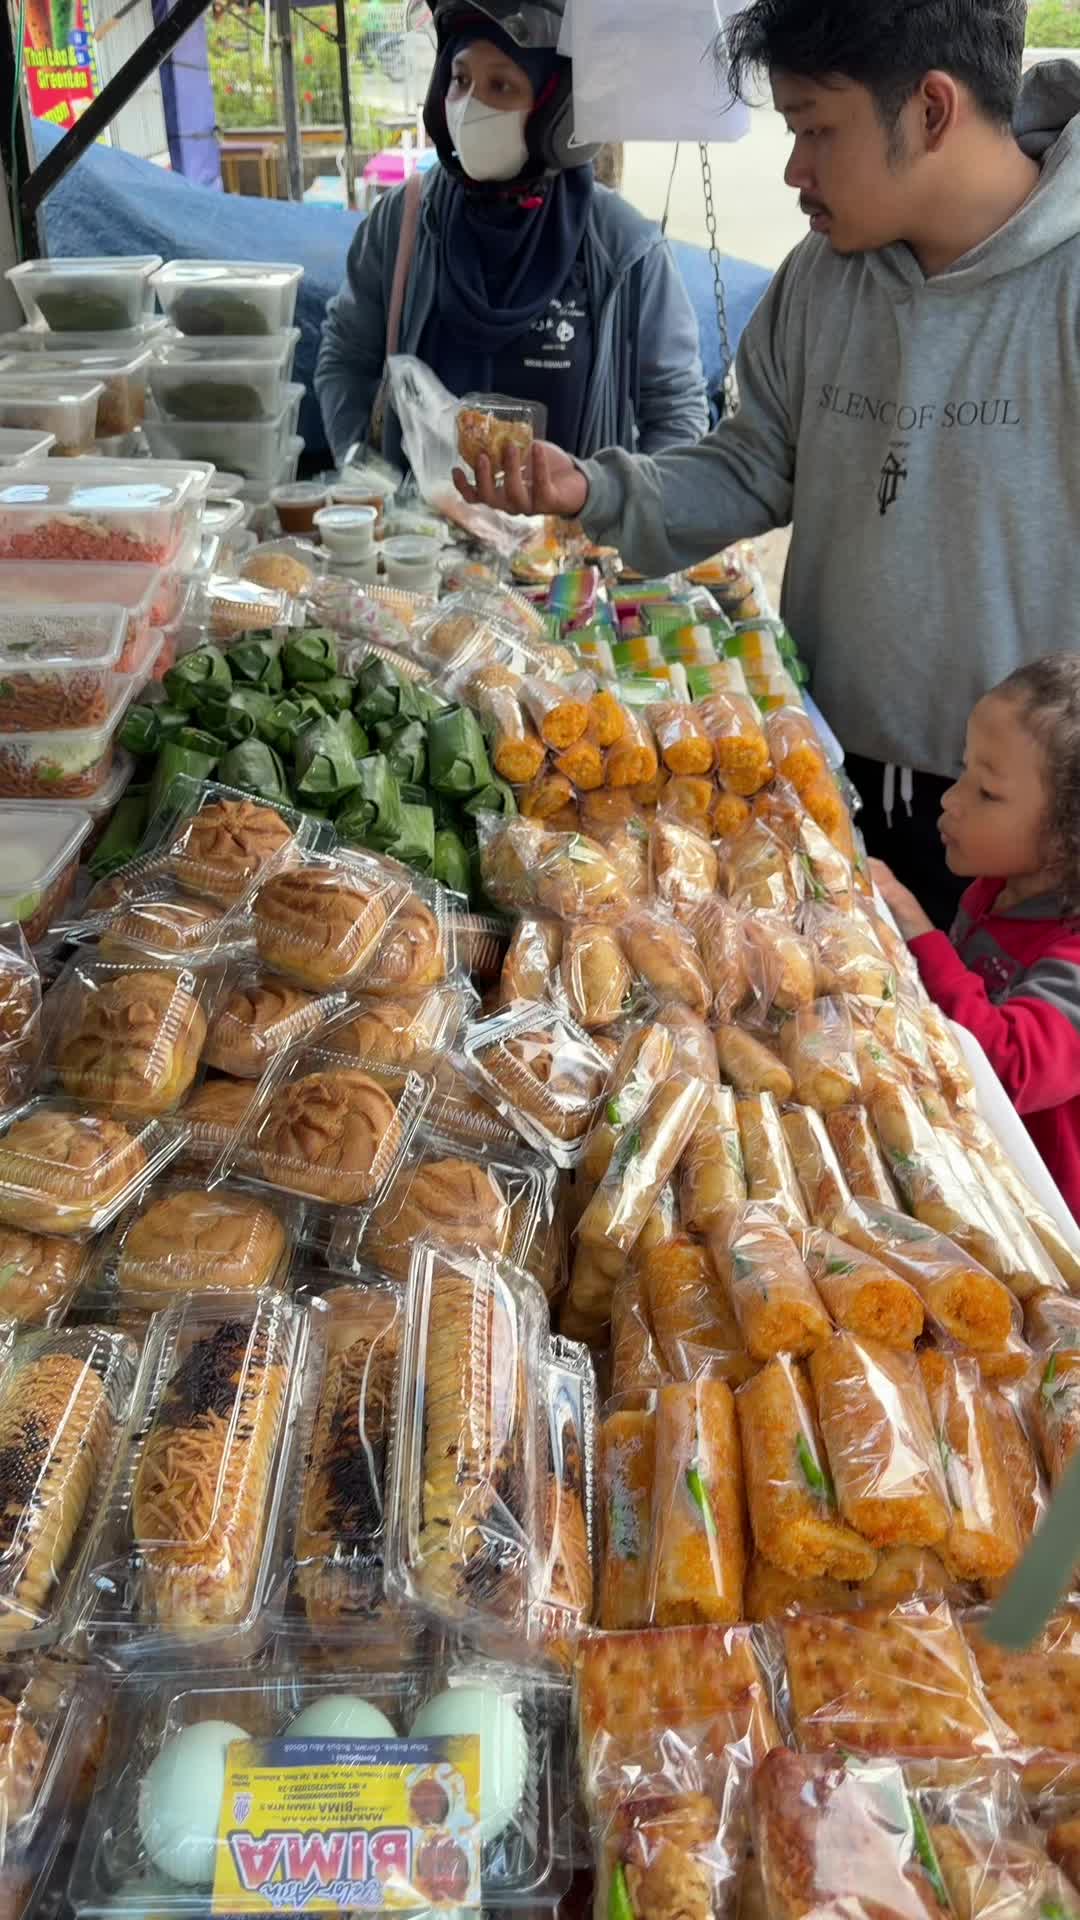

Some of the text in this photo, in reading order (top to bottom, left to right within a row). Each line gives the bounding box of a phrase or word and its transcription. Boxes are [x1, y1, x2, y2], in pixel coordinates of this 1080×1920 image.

[941, 399, 1020, 428] SOUL
[319, 1802, 354, 1813] BIMA
[228, 1827, 412, 1890] BIMA
[259, 1880, 321, 1910] Asin
